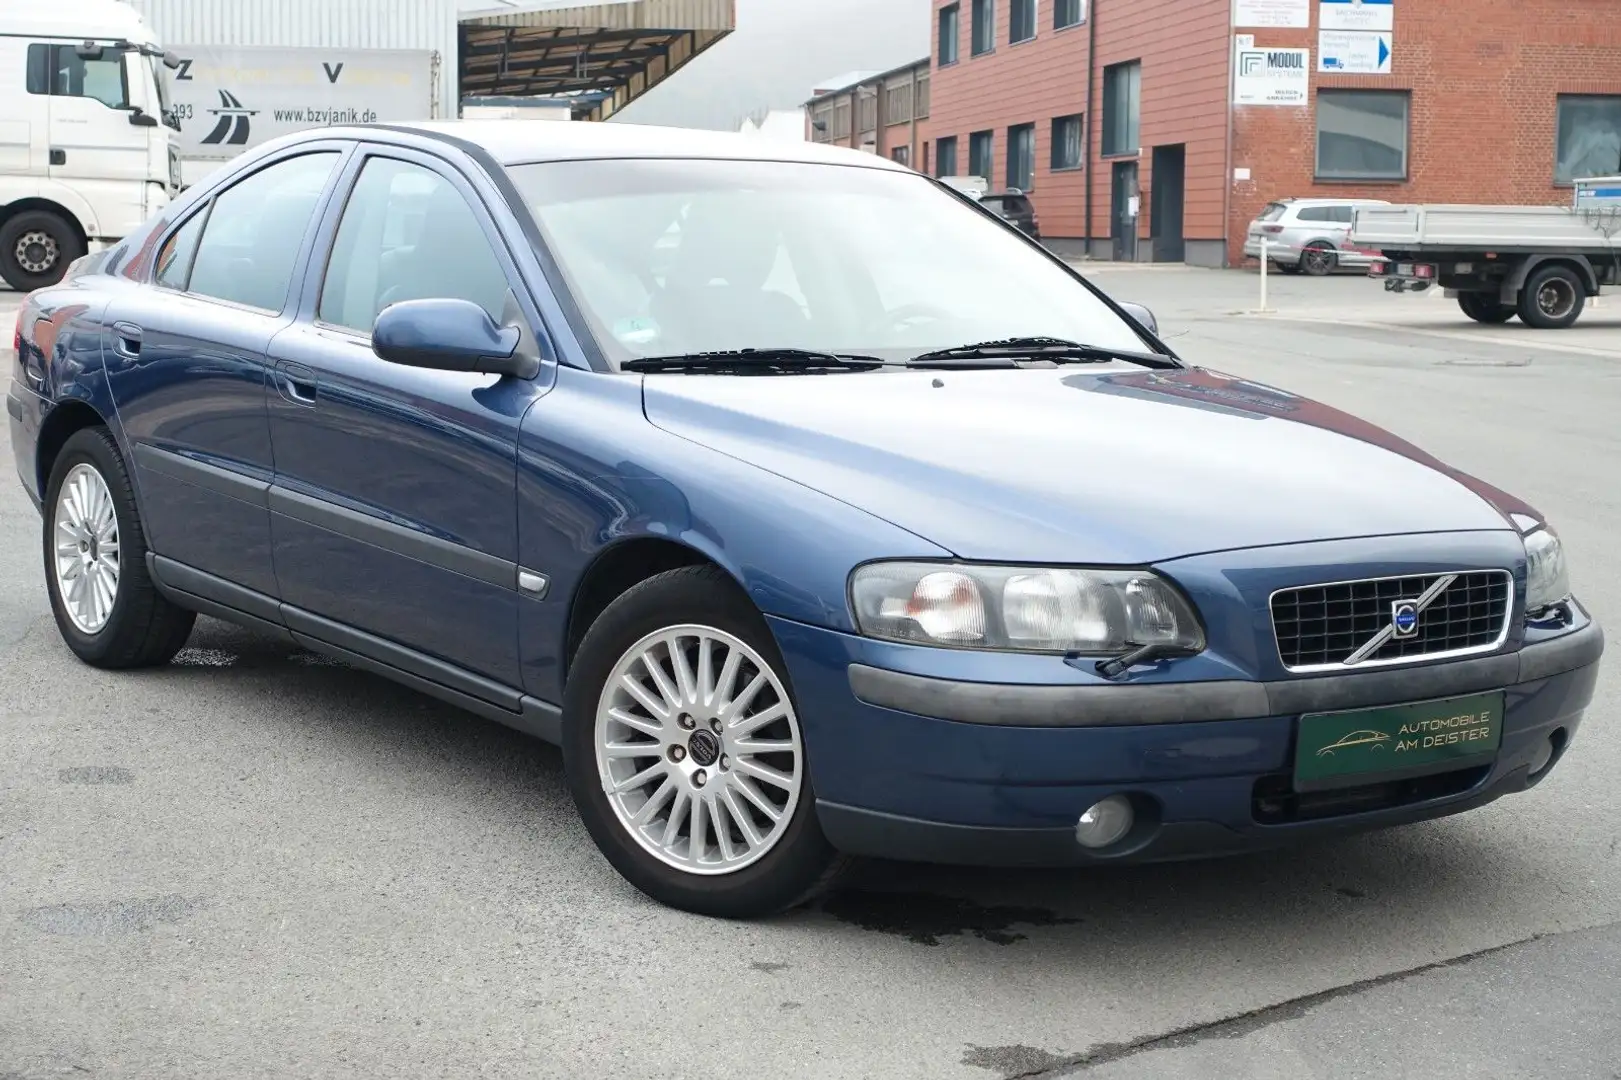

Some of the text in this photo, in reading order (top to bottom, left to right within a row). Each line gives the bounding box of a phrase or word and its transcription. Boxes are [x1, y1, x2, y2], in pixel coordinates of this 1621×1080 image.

[1267, 52, 1304, 69] MODUL
[273, 106, 377, 125] www.bzvjanik.de
[1398, 711, 1490, 735] AUTOMOBILE
[1395, 727, 1490, 752] AM DEISTER
